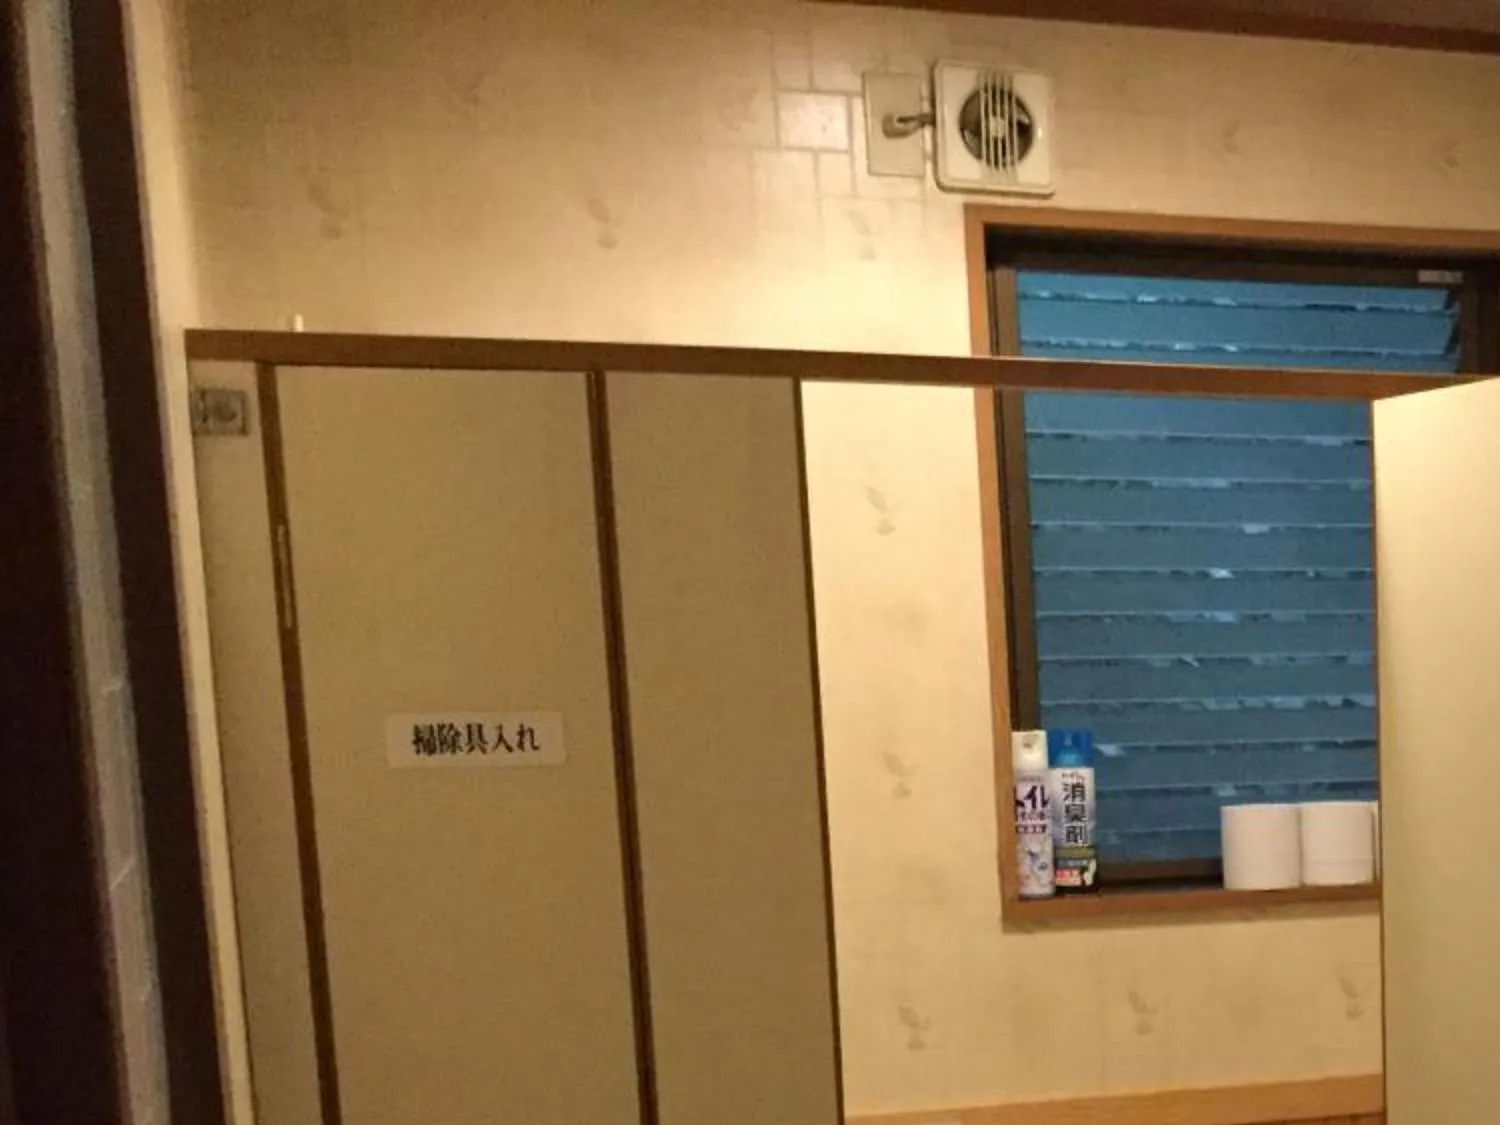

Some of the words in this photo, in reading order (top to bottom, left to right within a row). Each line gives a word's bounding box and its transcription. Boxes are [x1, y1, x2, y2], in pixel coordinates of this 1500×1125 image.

[411, 720, 541, 756] 掃除具入れ
